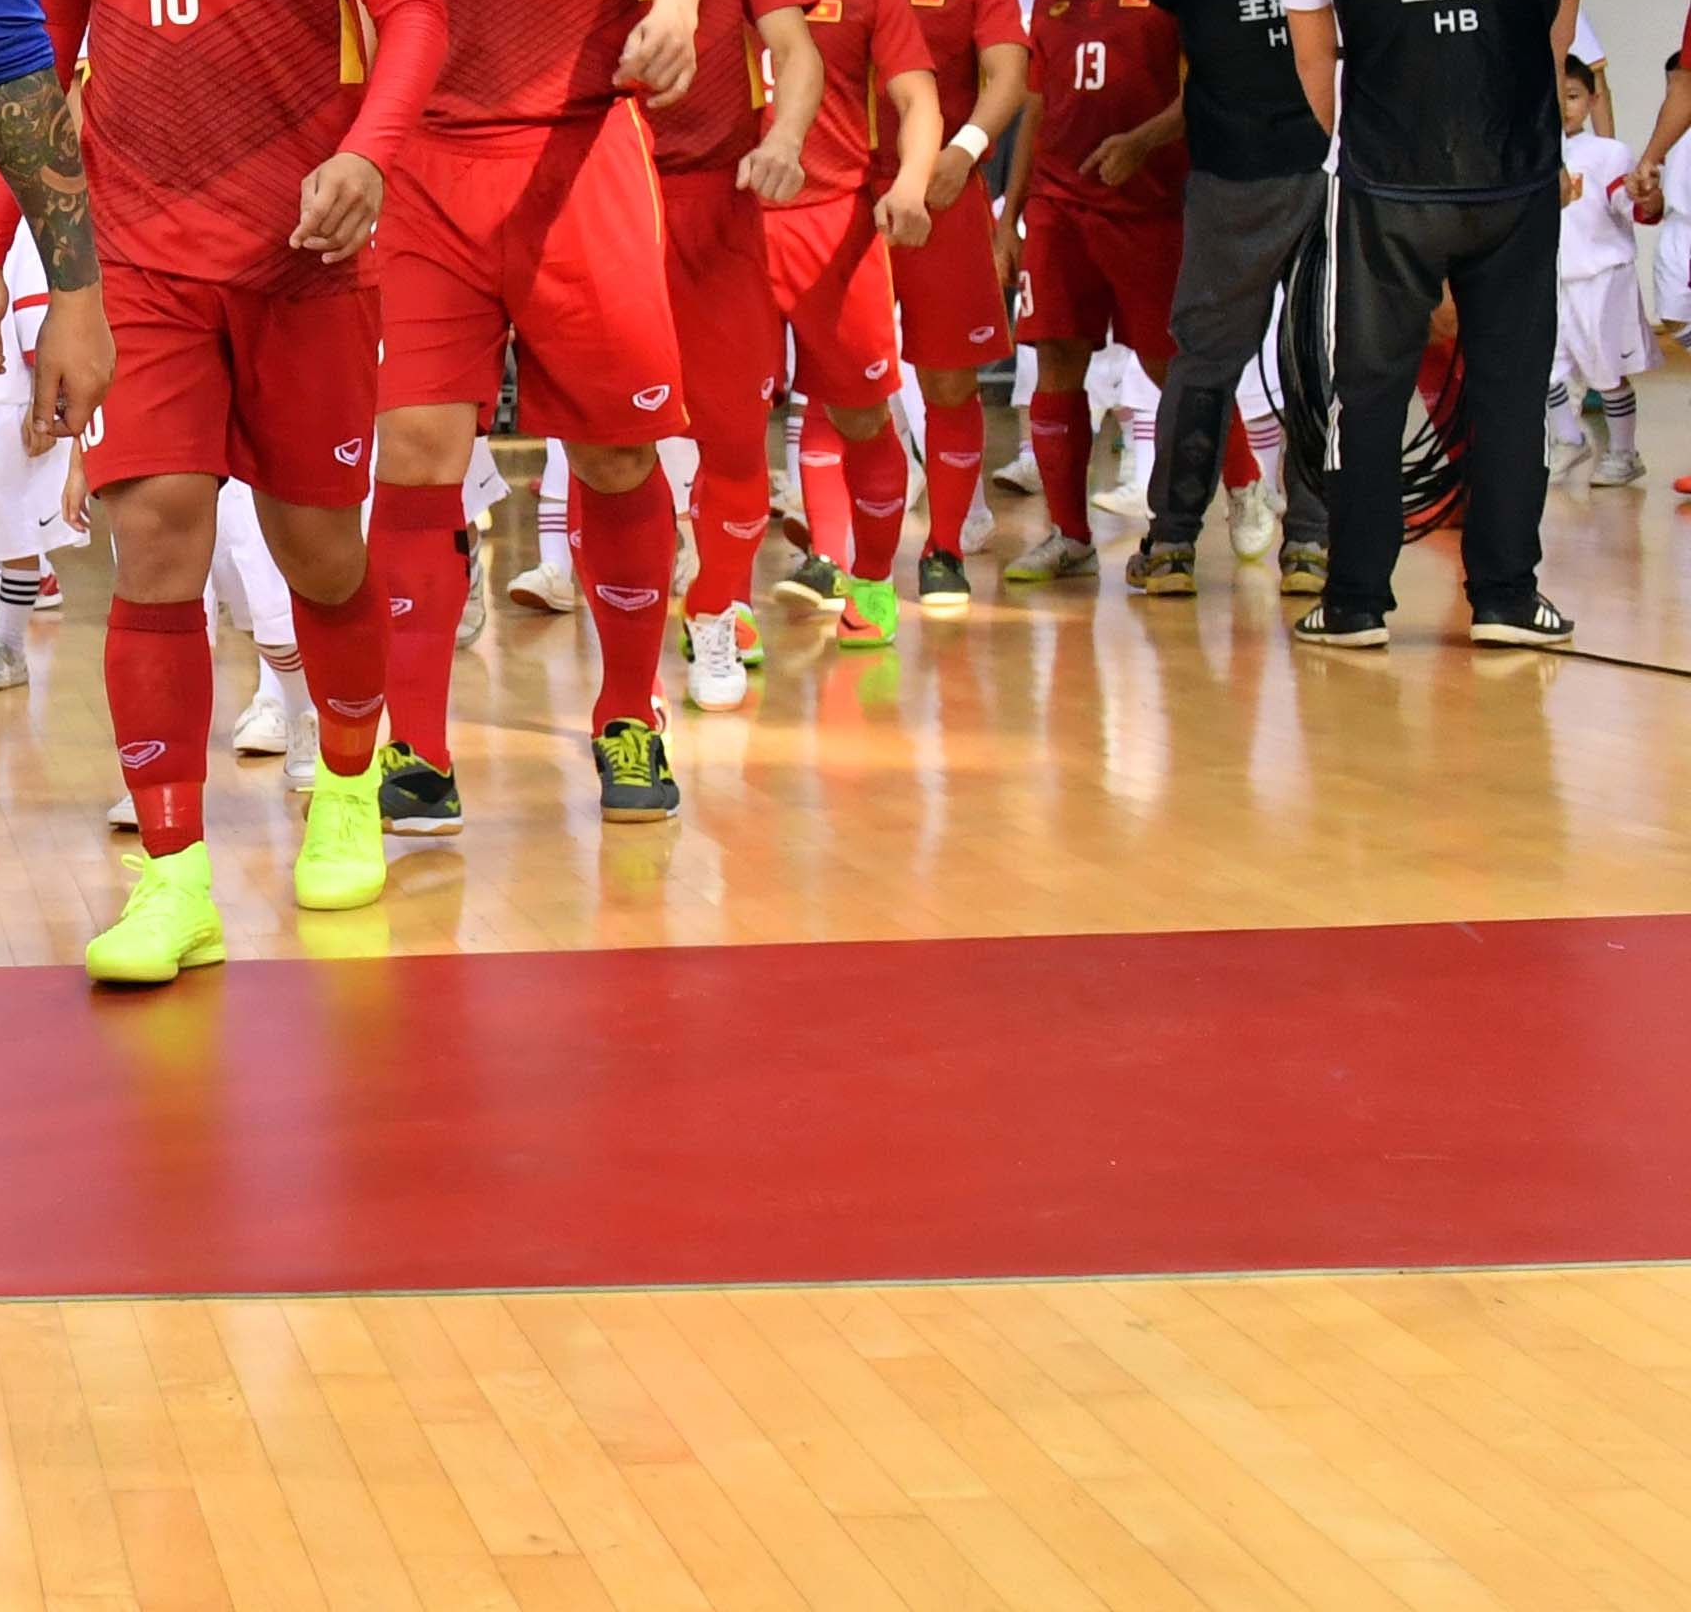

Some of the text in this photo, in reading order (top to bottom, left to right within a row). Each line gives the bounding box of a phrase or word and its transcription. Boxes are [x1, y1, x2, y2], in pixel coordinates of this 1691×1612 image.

[1434, 9, 1478, 34] HB
[1267, 26, 1288, 47] H
[1075, 40, 1105, 90] 13
